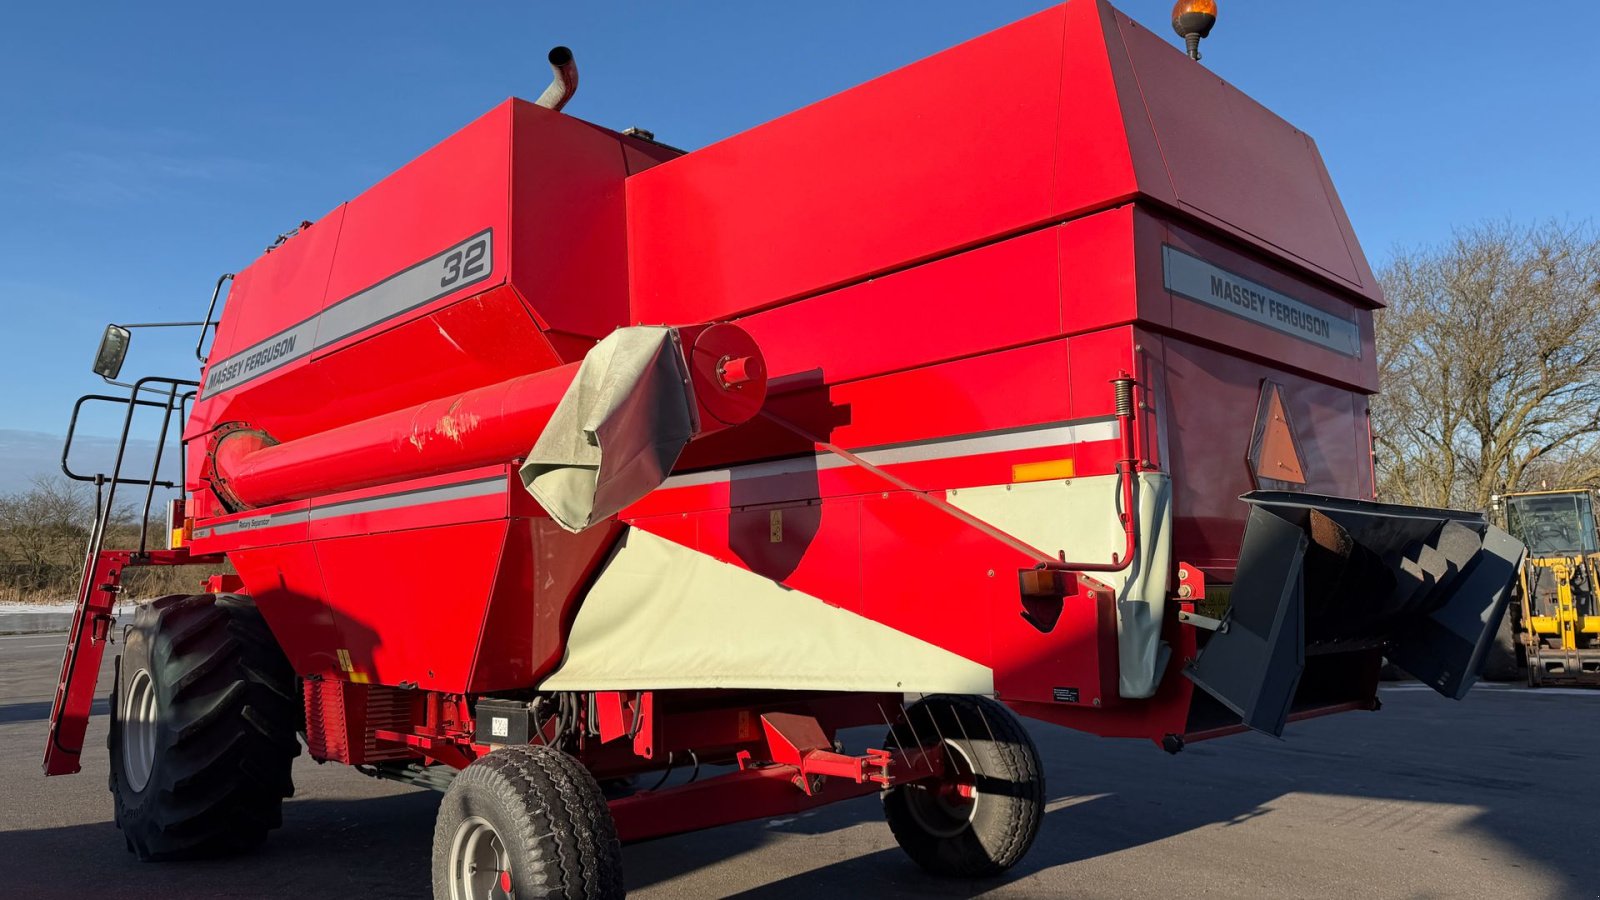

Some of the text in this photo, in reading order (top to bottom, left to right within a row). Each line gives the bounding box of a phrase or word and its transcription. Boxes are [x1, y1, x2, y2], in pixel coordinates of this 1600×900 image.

[440, 239, 487, 288] 32
[1210, 275, 1330, 339] MASSEY FERGUSON
[208, 335, 296, 390] MASSEY FERGUSON
